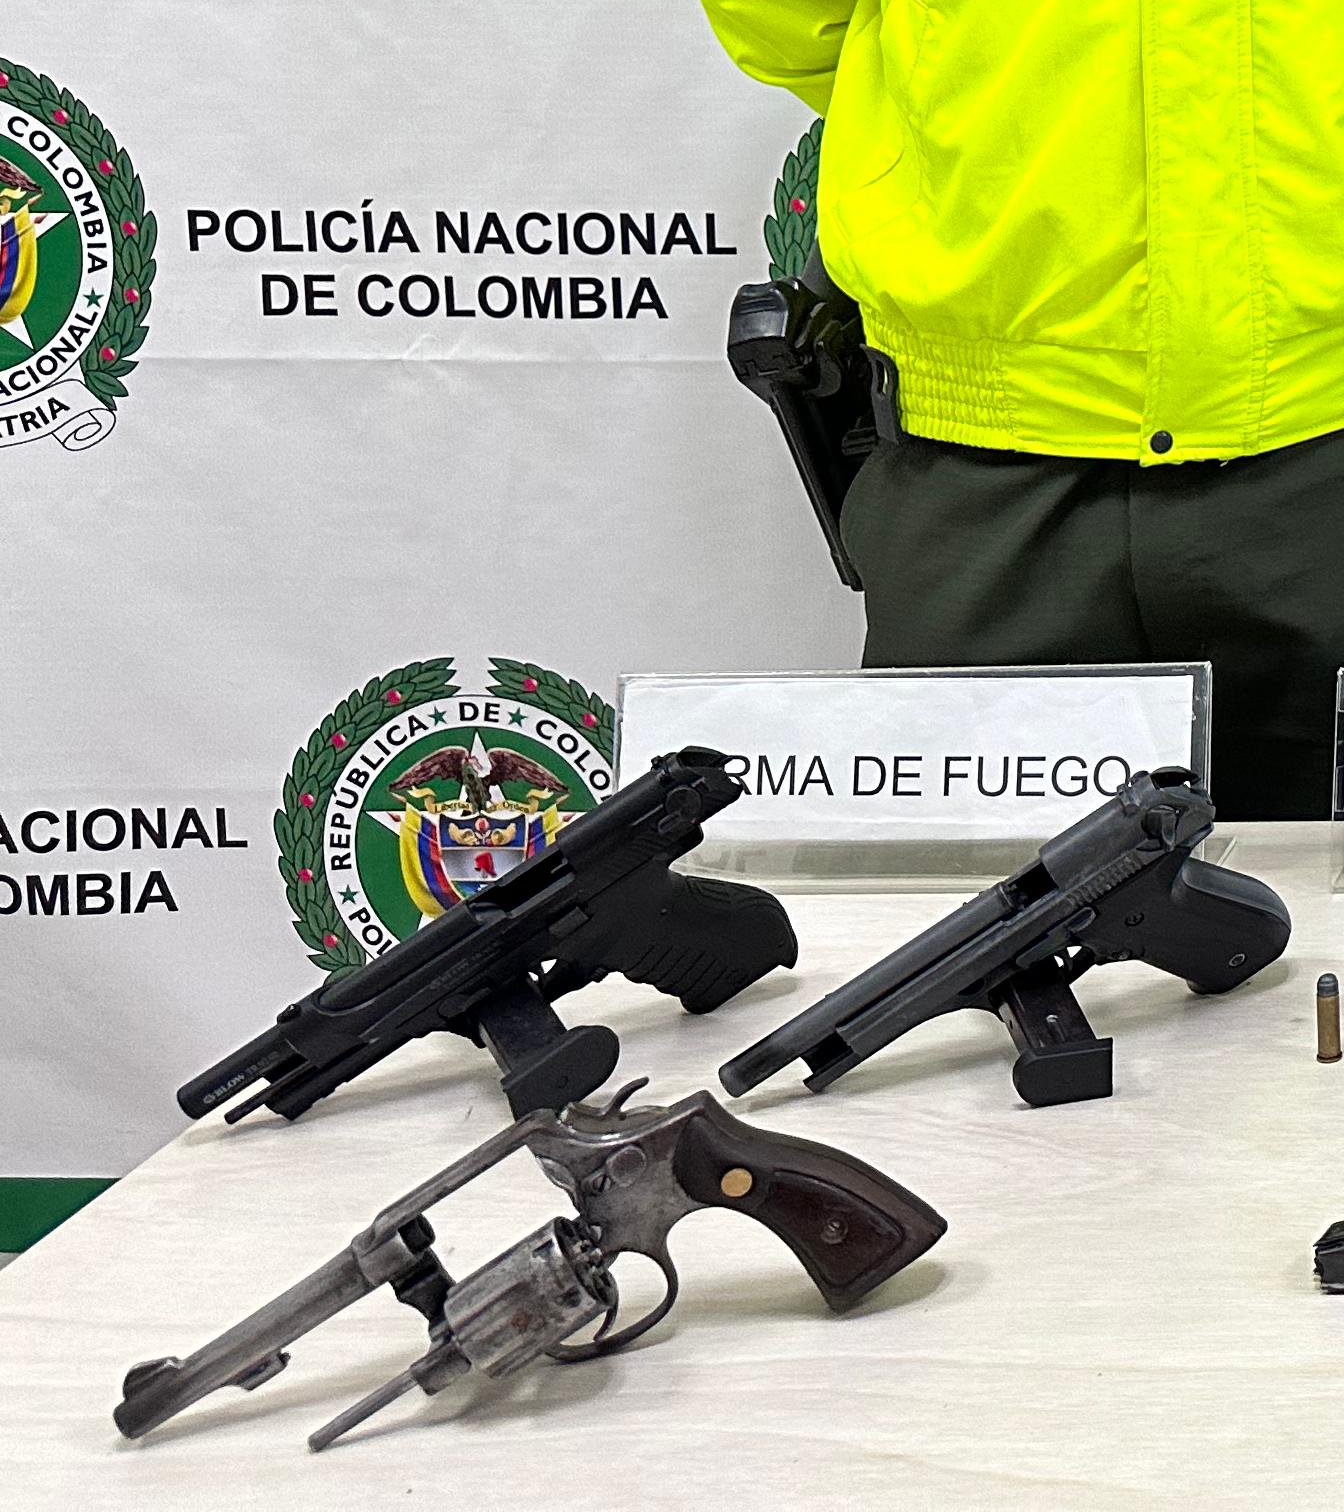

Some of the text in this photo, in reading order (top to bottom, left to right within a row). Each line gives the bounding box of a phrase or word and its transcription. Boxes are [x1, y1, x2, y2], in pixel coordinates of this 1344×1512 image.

[7, 115, 108, 274] COLOMBIA
[187, 198, 738, 256] POLICÍA NACIONAL
[261, 273, 669, 320] DE COLOMBIA
[331, 714, 429, 872] REPÚBLICA
[459, 701, 500, 723] DE
[724, 754, 1132, 798] RMA DE FUEGO
